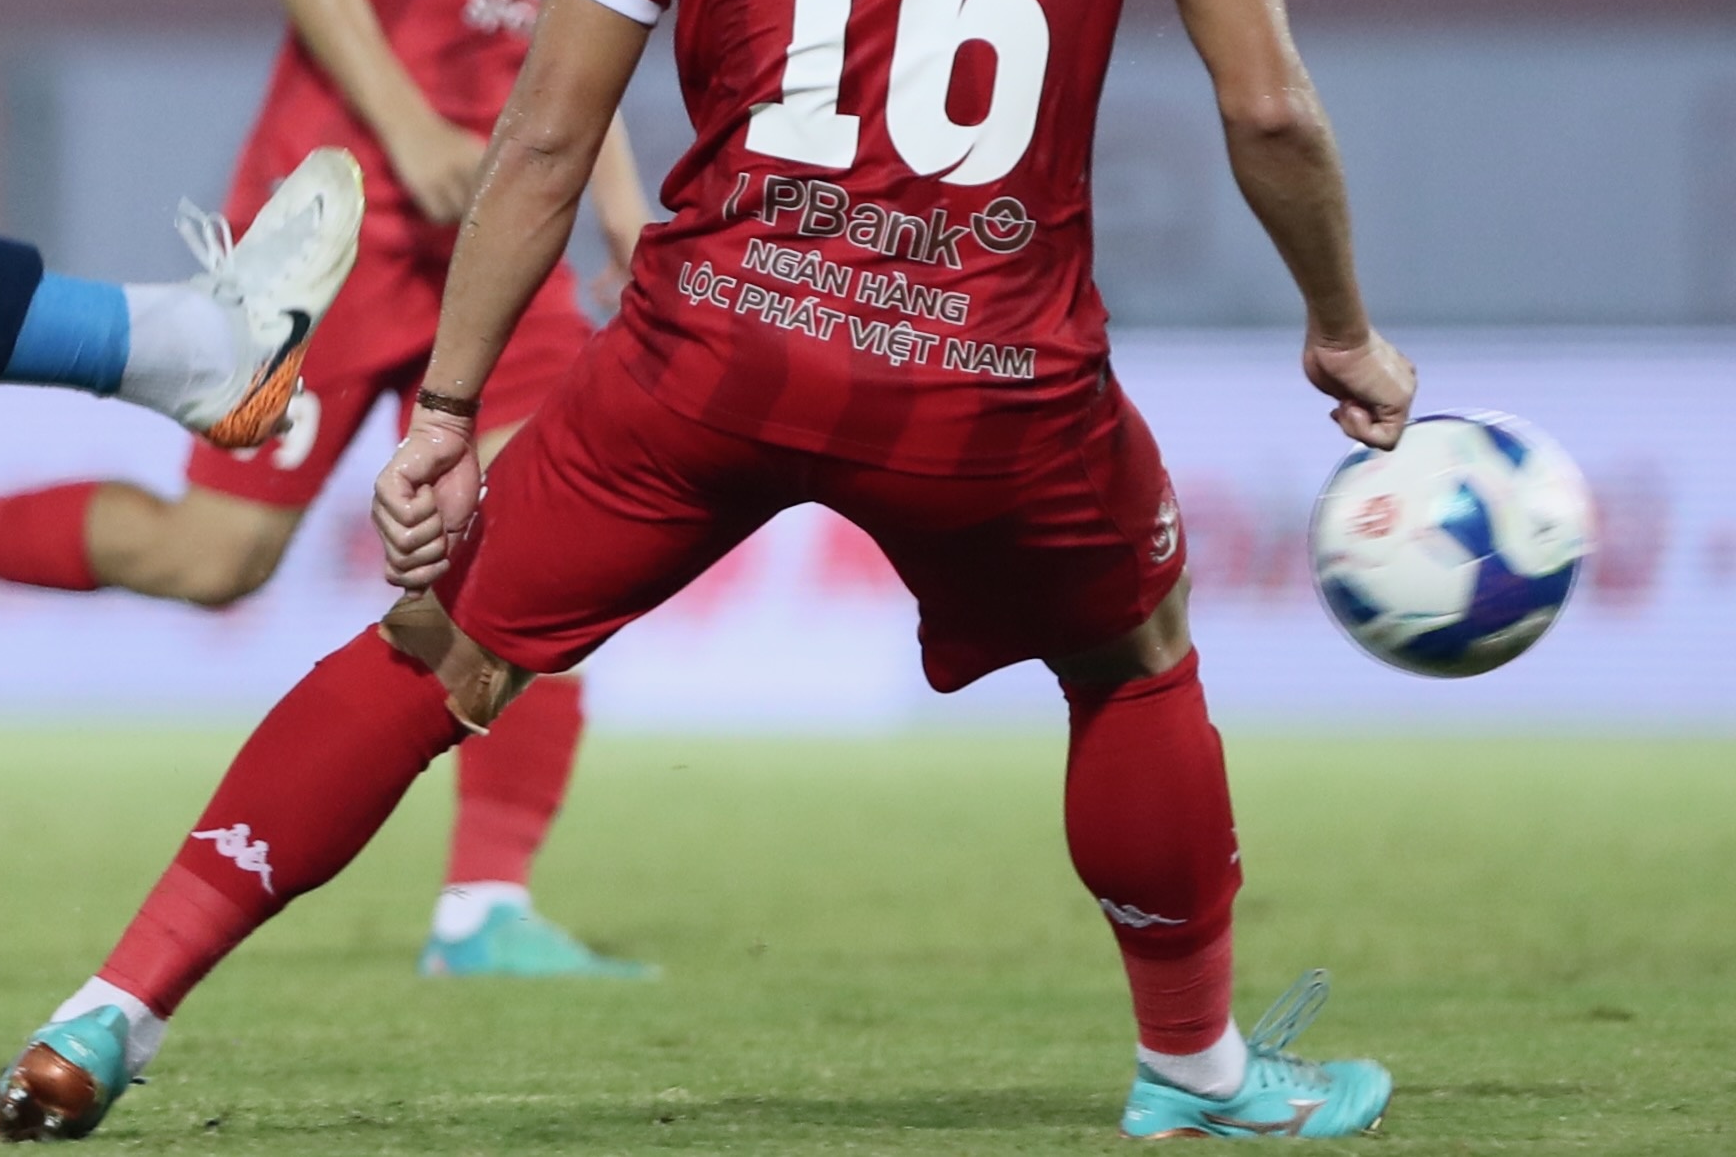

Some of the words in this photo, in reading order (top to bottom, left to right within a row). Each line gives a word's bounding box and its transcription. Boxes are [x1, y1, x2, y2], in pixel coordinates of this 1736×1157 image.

[722, 172, 970, 269] LPBank
[679, 261, 737, 305] LỘC
[735, 283, 845, 341] PHÁT
[848, 316, 940, 366] VIỆT
[942, 338, 1036, 379] NAM
[741, 238, 853, 297] NGÂN
[855, 271, 969, 325] HÀNG
